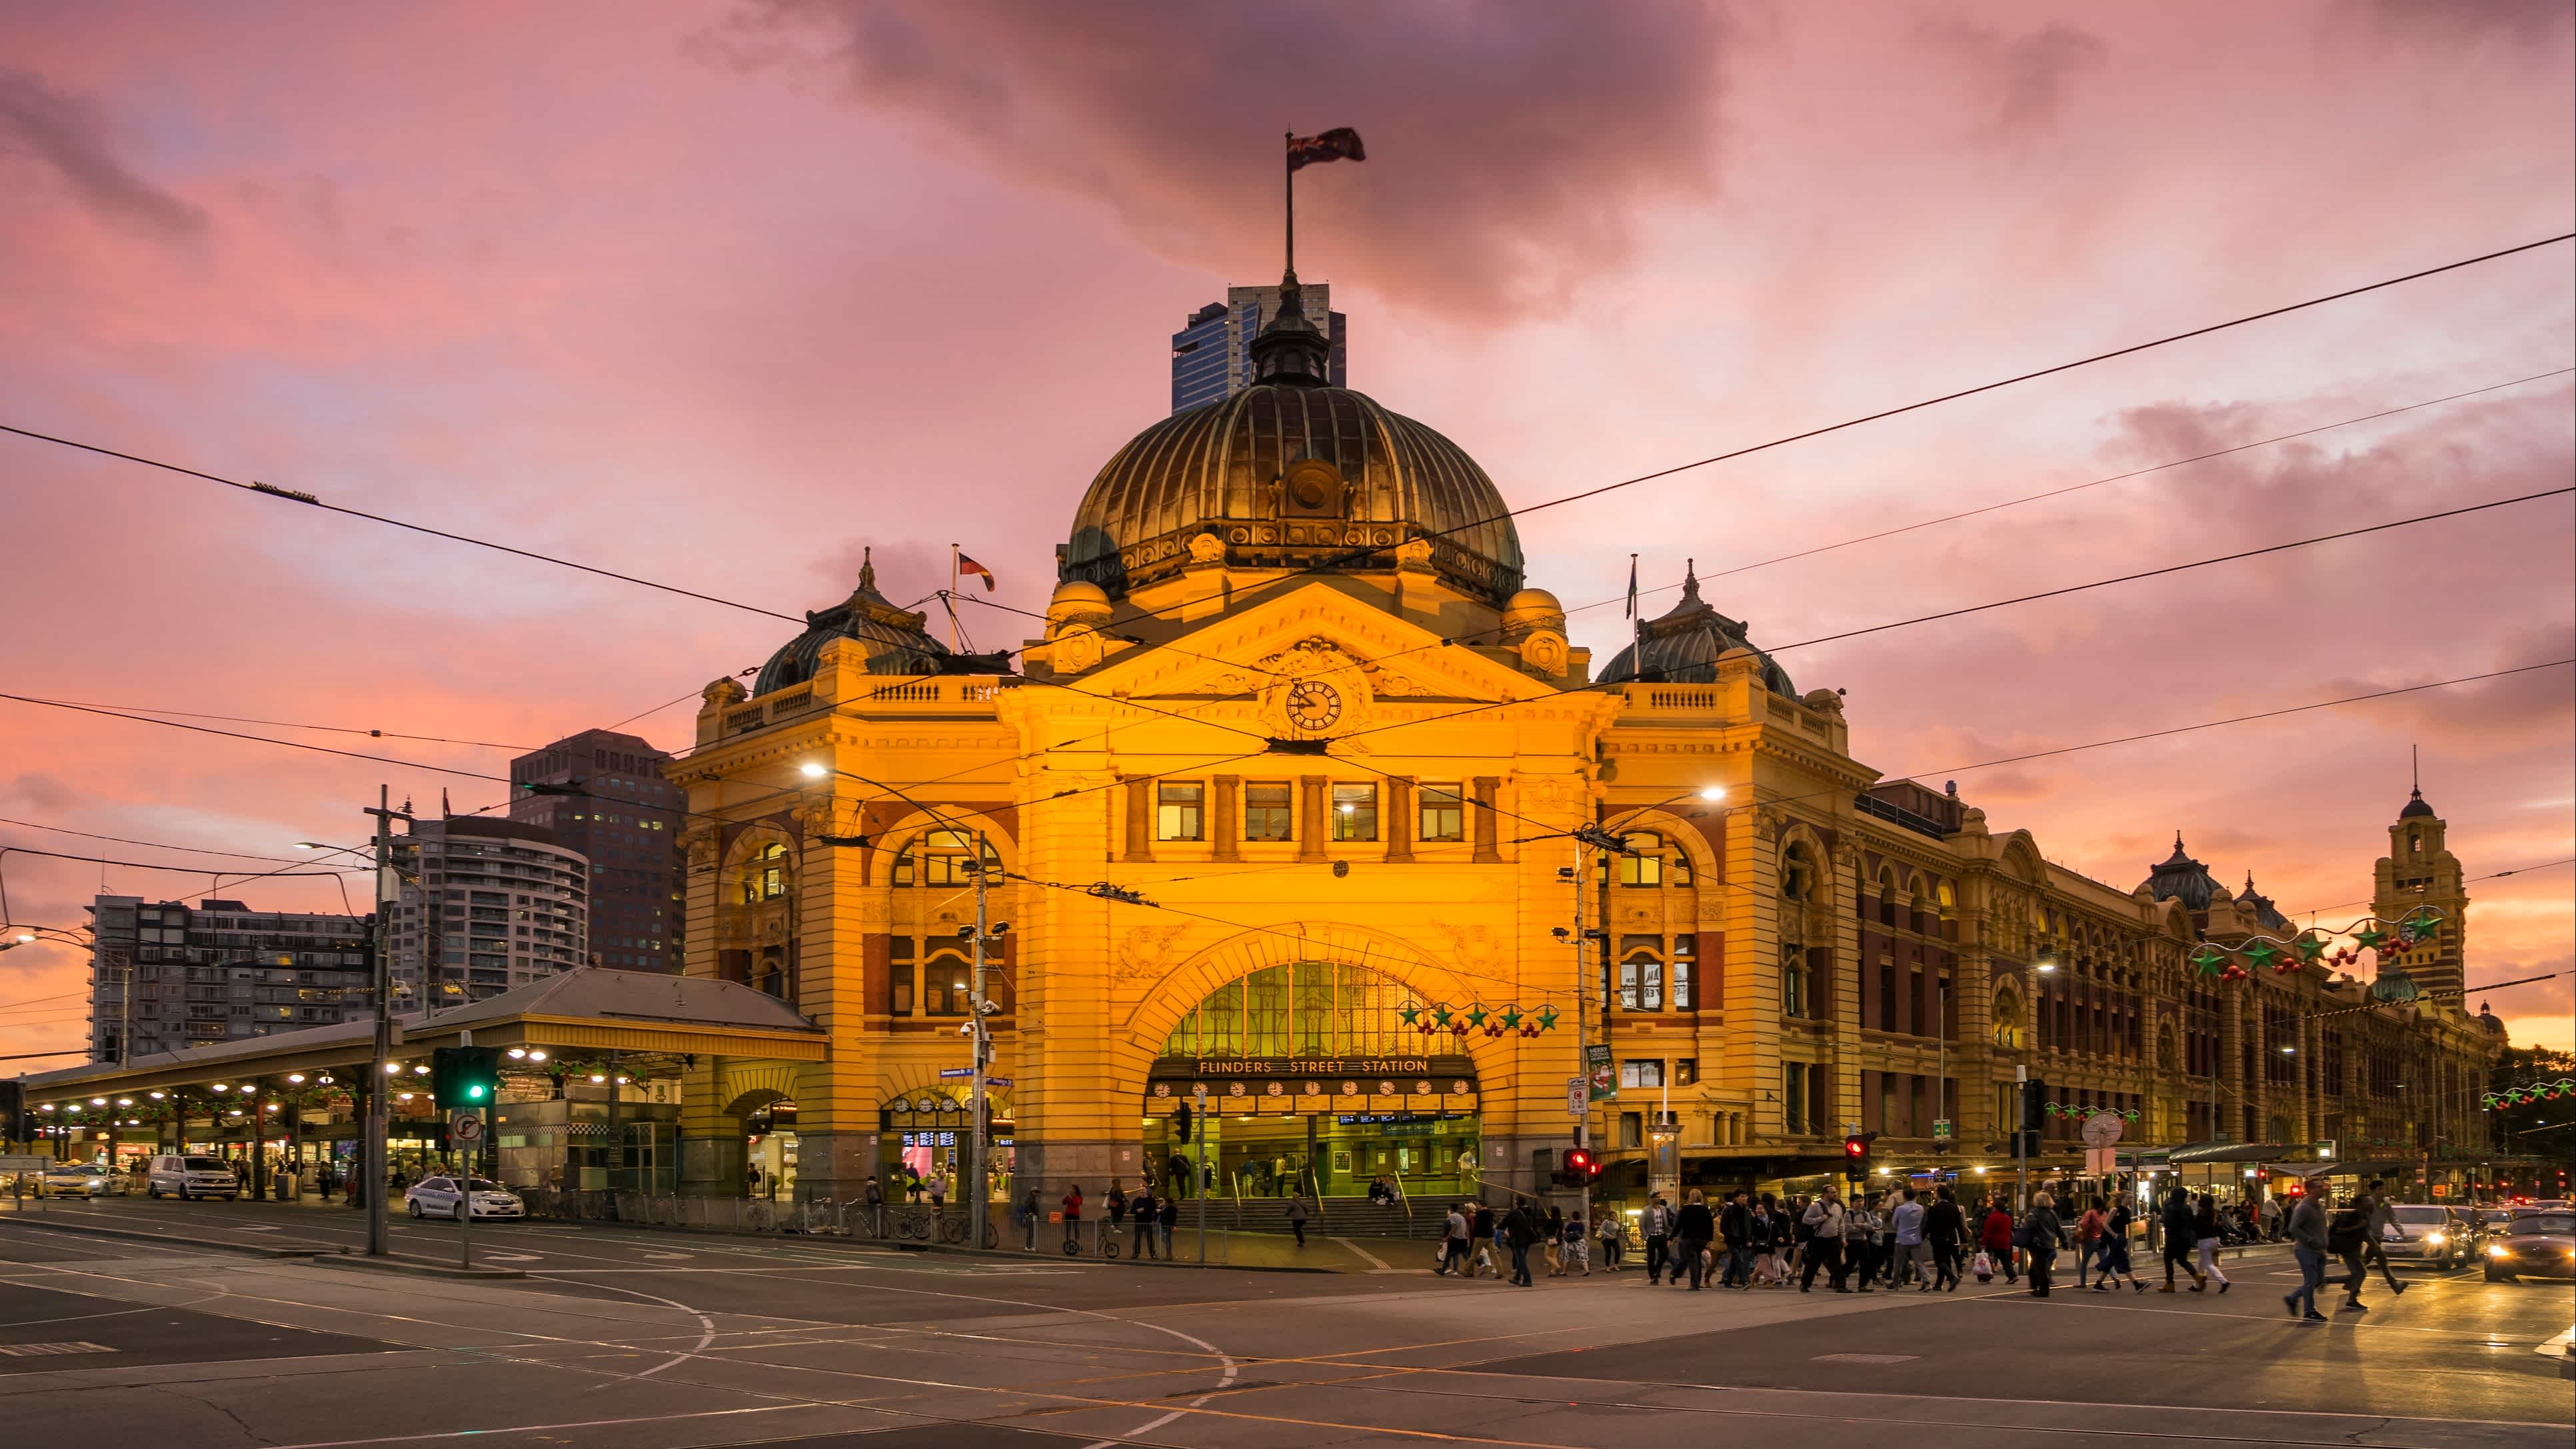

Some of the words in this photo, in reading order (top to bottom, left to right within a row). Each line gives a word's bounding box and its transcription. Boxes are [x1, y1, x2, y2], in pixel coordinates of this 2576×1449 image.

[1200, 1062, 1271, 1072] FLINDERS
[1290, 1061, 1344, 1072] STREET
[1362, 1060, 1427, 1072] STATION
